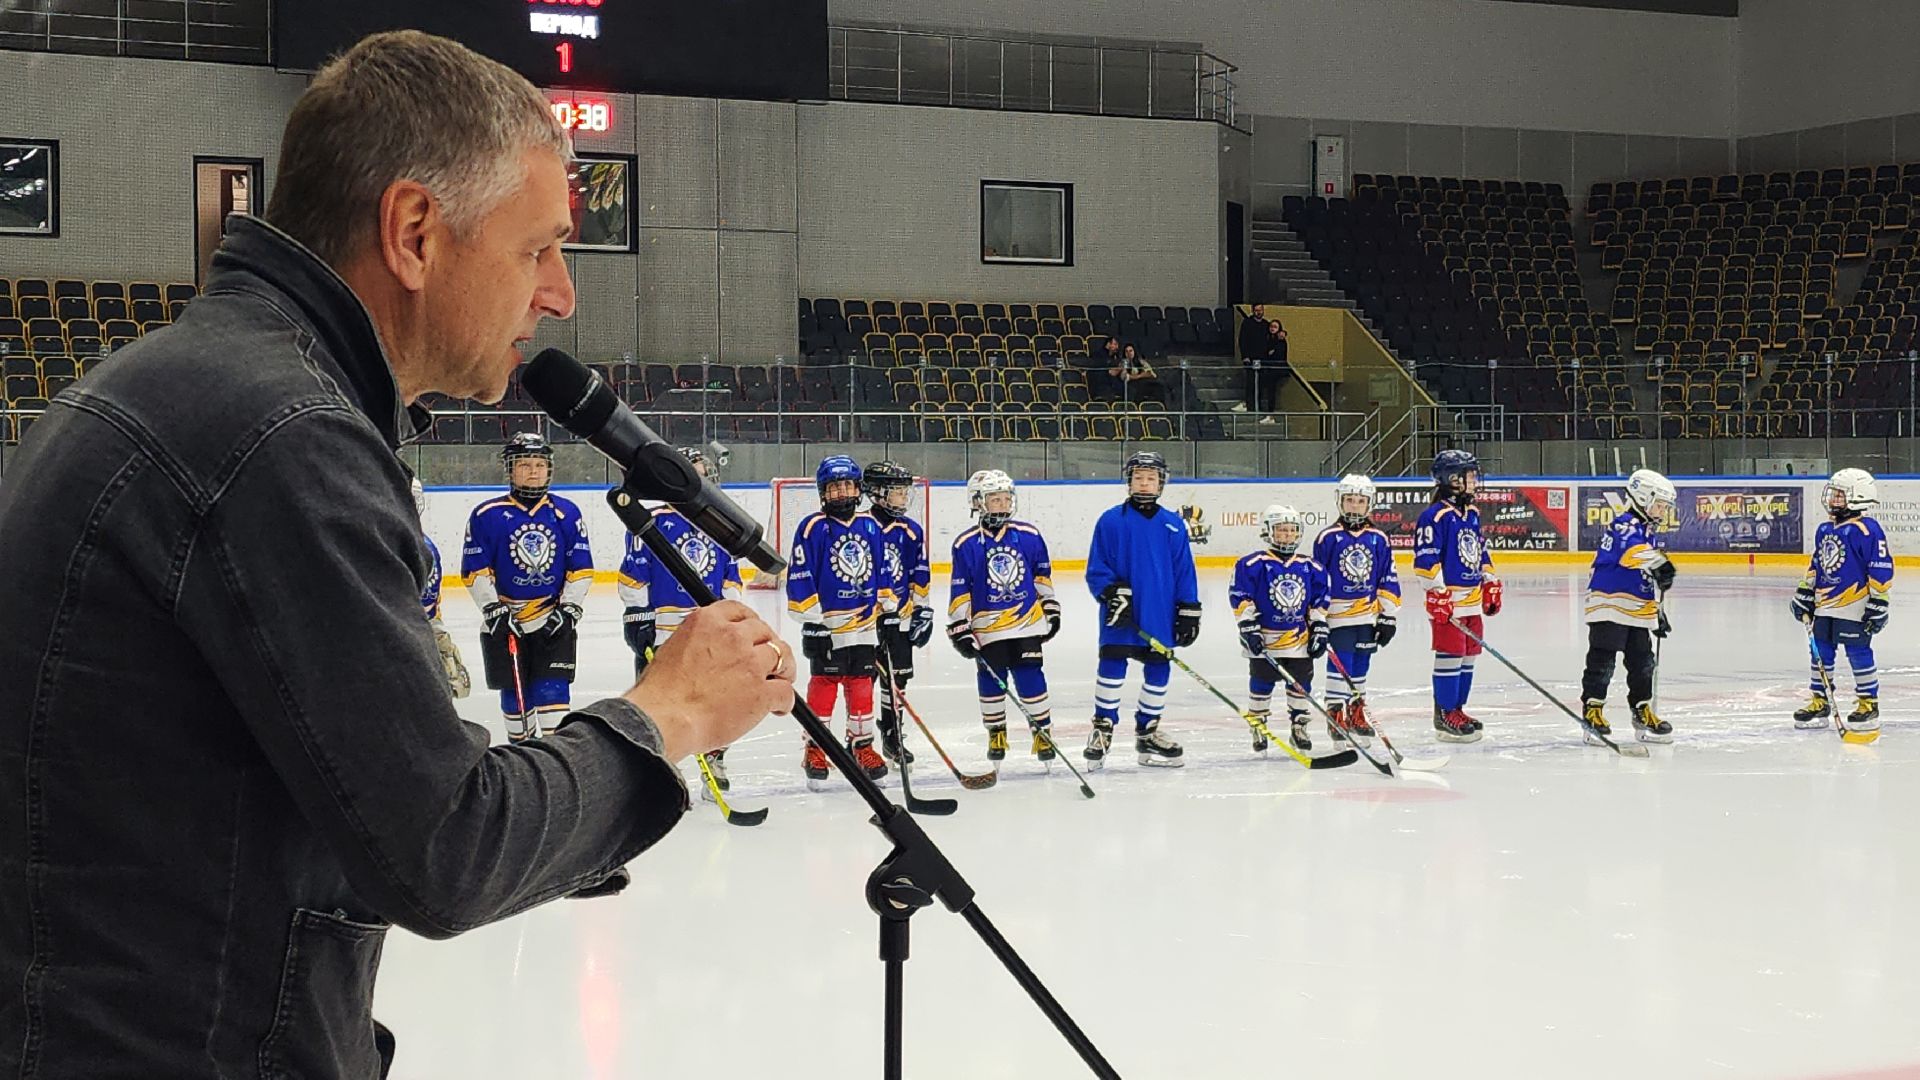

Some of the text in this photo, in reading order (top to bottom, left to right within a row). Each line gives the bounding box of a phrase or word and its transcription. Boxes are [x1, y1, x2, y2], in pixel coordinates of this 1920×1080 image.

[555, 42, 572, 73] 1
[1416, 525, 1434, 547] 29
[1485, 536, 1520, 549] АЙМ
[1878, 540, 1887, 558] 5
